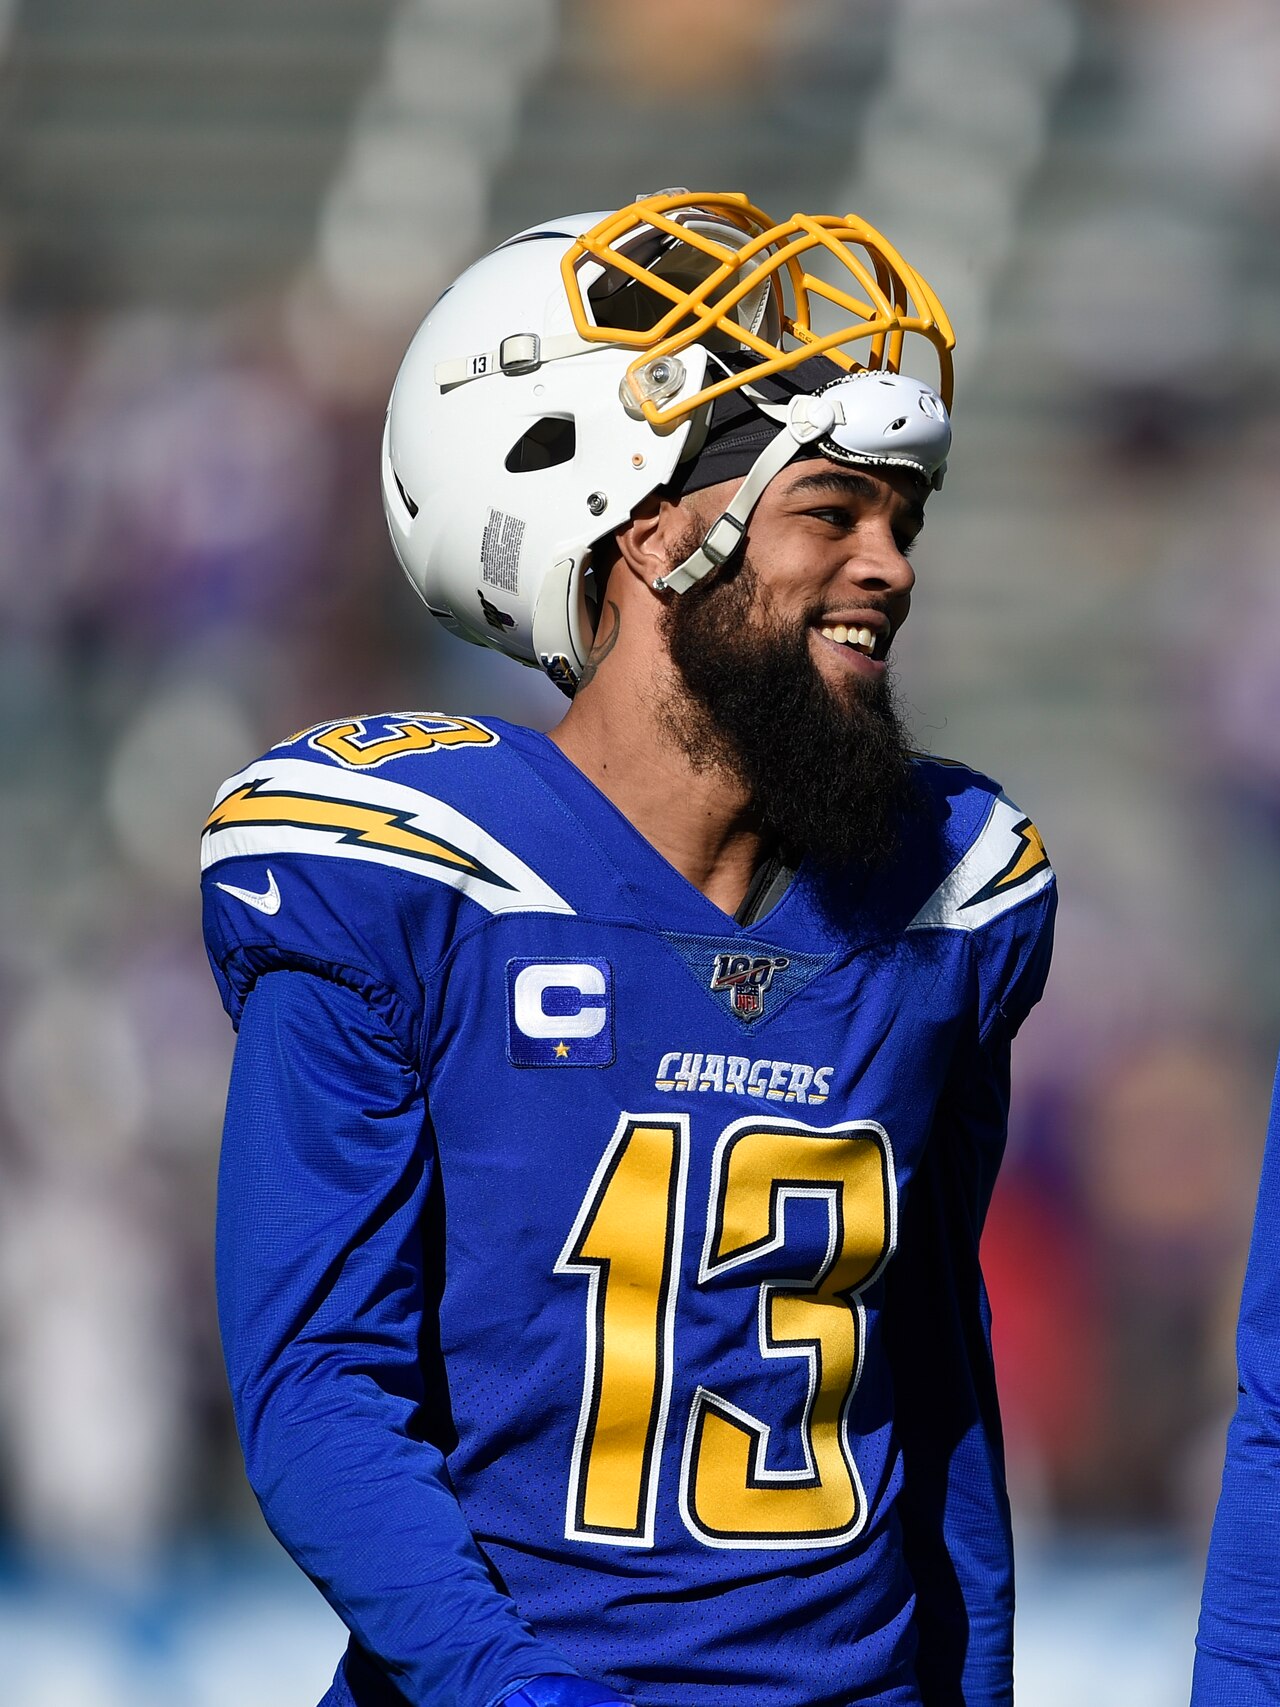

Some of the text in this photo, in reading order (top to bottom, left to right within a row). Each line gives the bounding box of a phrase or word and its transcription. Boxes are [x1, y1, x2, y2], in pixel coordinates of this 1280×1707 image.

[472, 356, 487, 375] 13
[480, 526, 488, 562] WARNING
[270, 711, 501, 770] 3
[713, 955, 773, 987] 100
[514, 963, 607, 1039] C
[737, 994, 758, 1010] NFL
[654, 1051, 835, 1105] CHARGERS
[553, 1111, 898, 1550] 13
